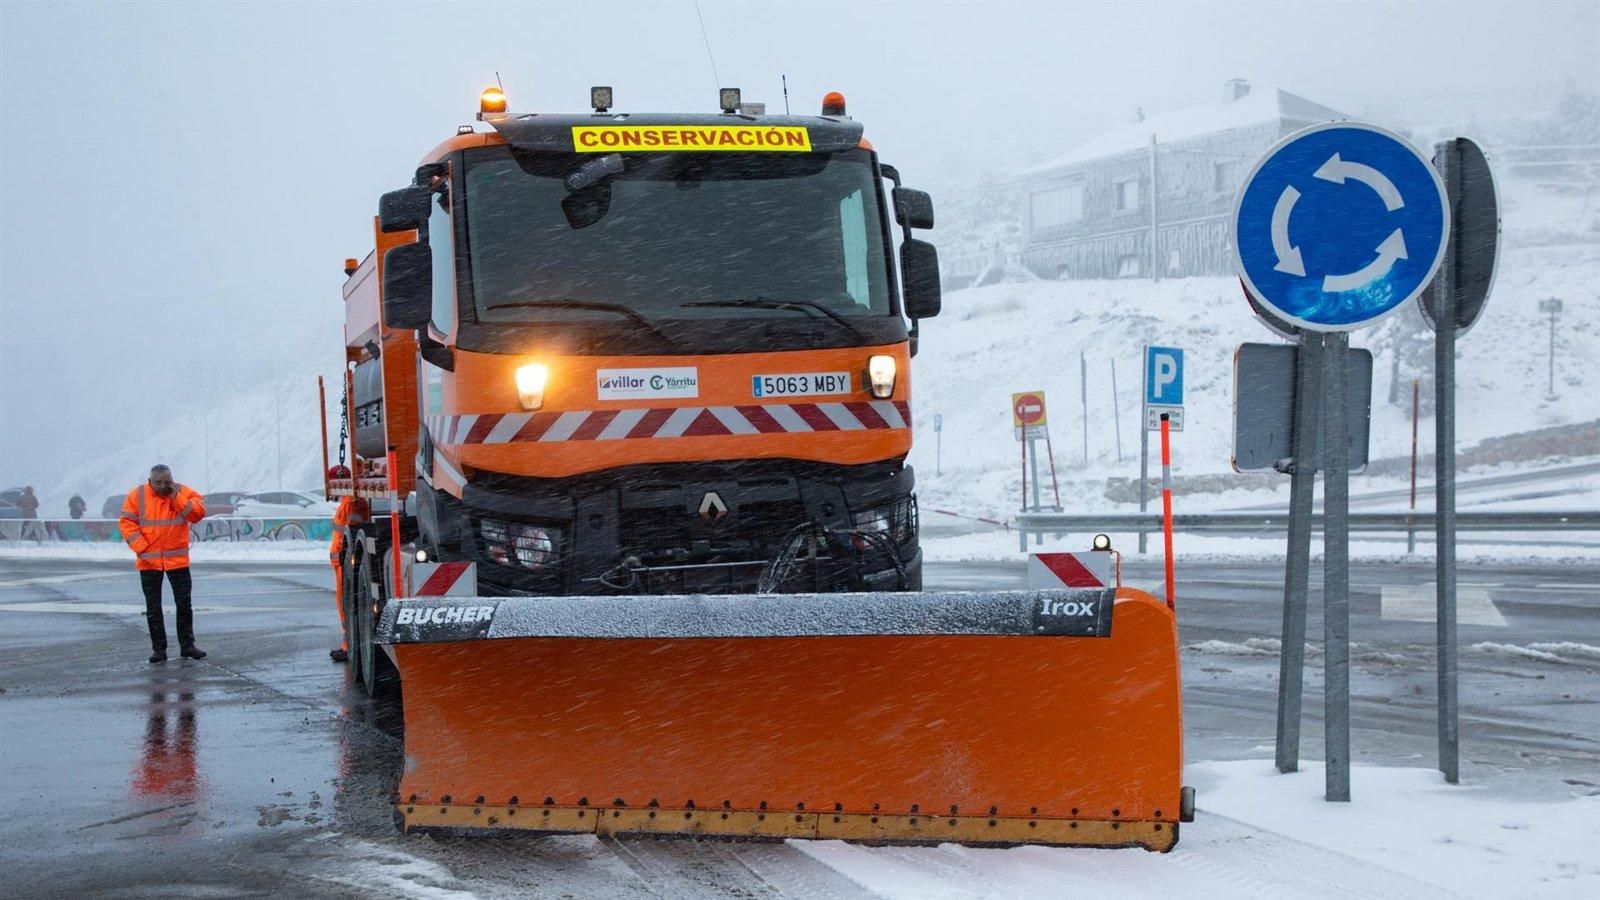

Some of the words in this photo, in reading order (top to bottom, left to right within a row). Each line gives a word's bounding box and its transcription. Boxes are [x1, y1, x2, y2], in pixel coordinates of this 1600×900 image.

[579, 127, 805, 147] CONSERVACIÓN
[611, 376, 645, 388] villar
[764, 376, 809, 394] 5063
[814, 375, 846, 392] MBY
[397, 606, 495, 625] BUCHER
[1040, 599, 1095, 616] Irox
